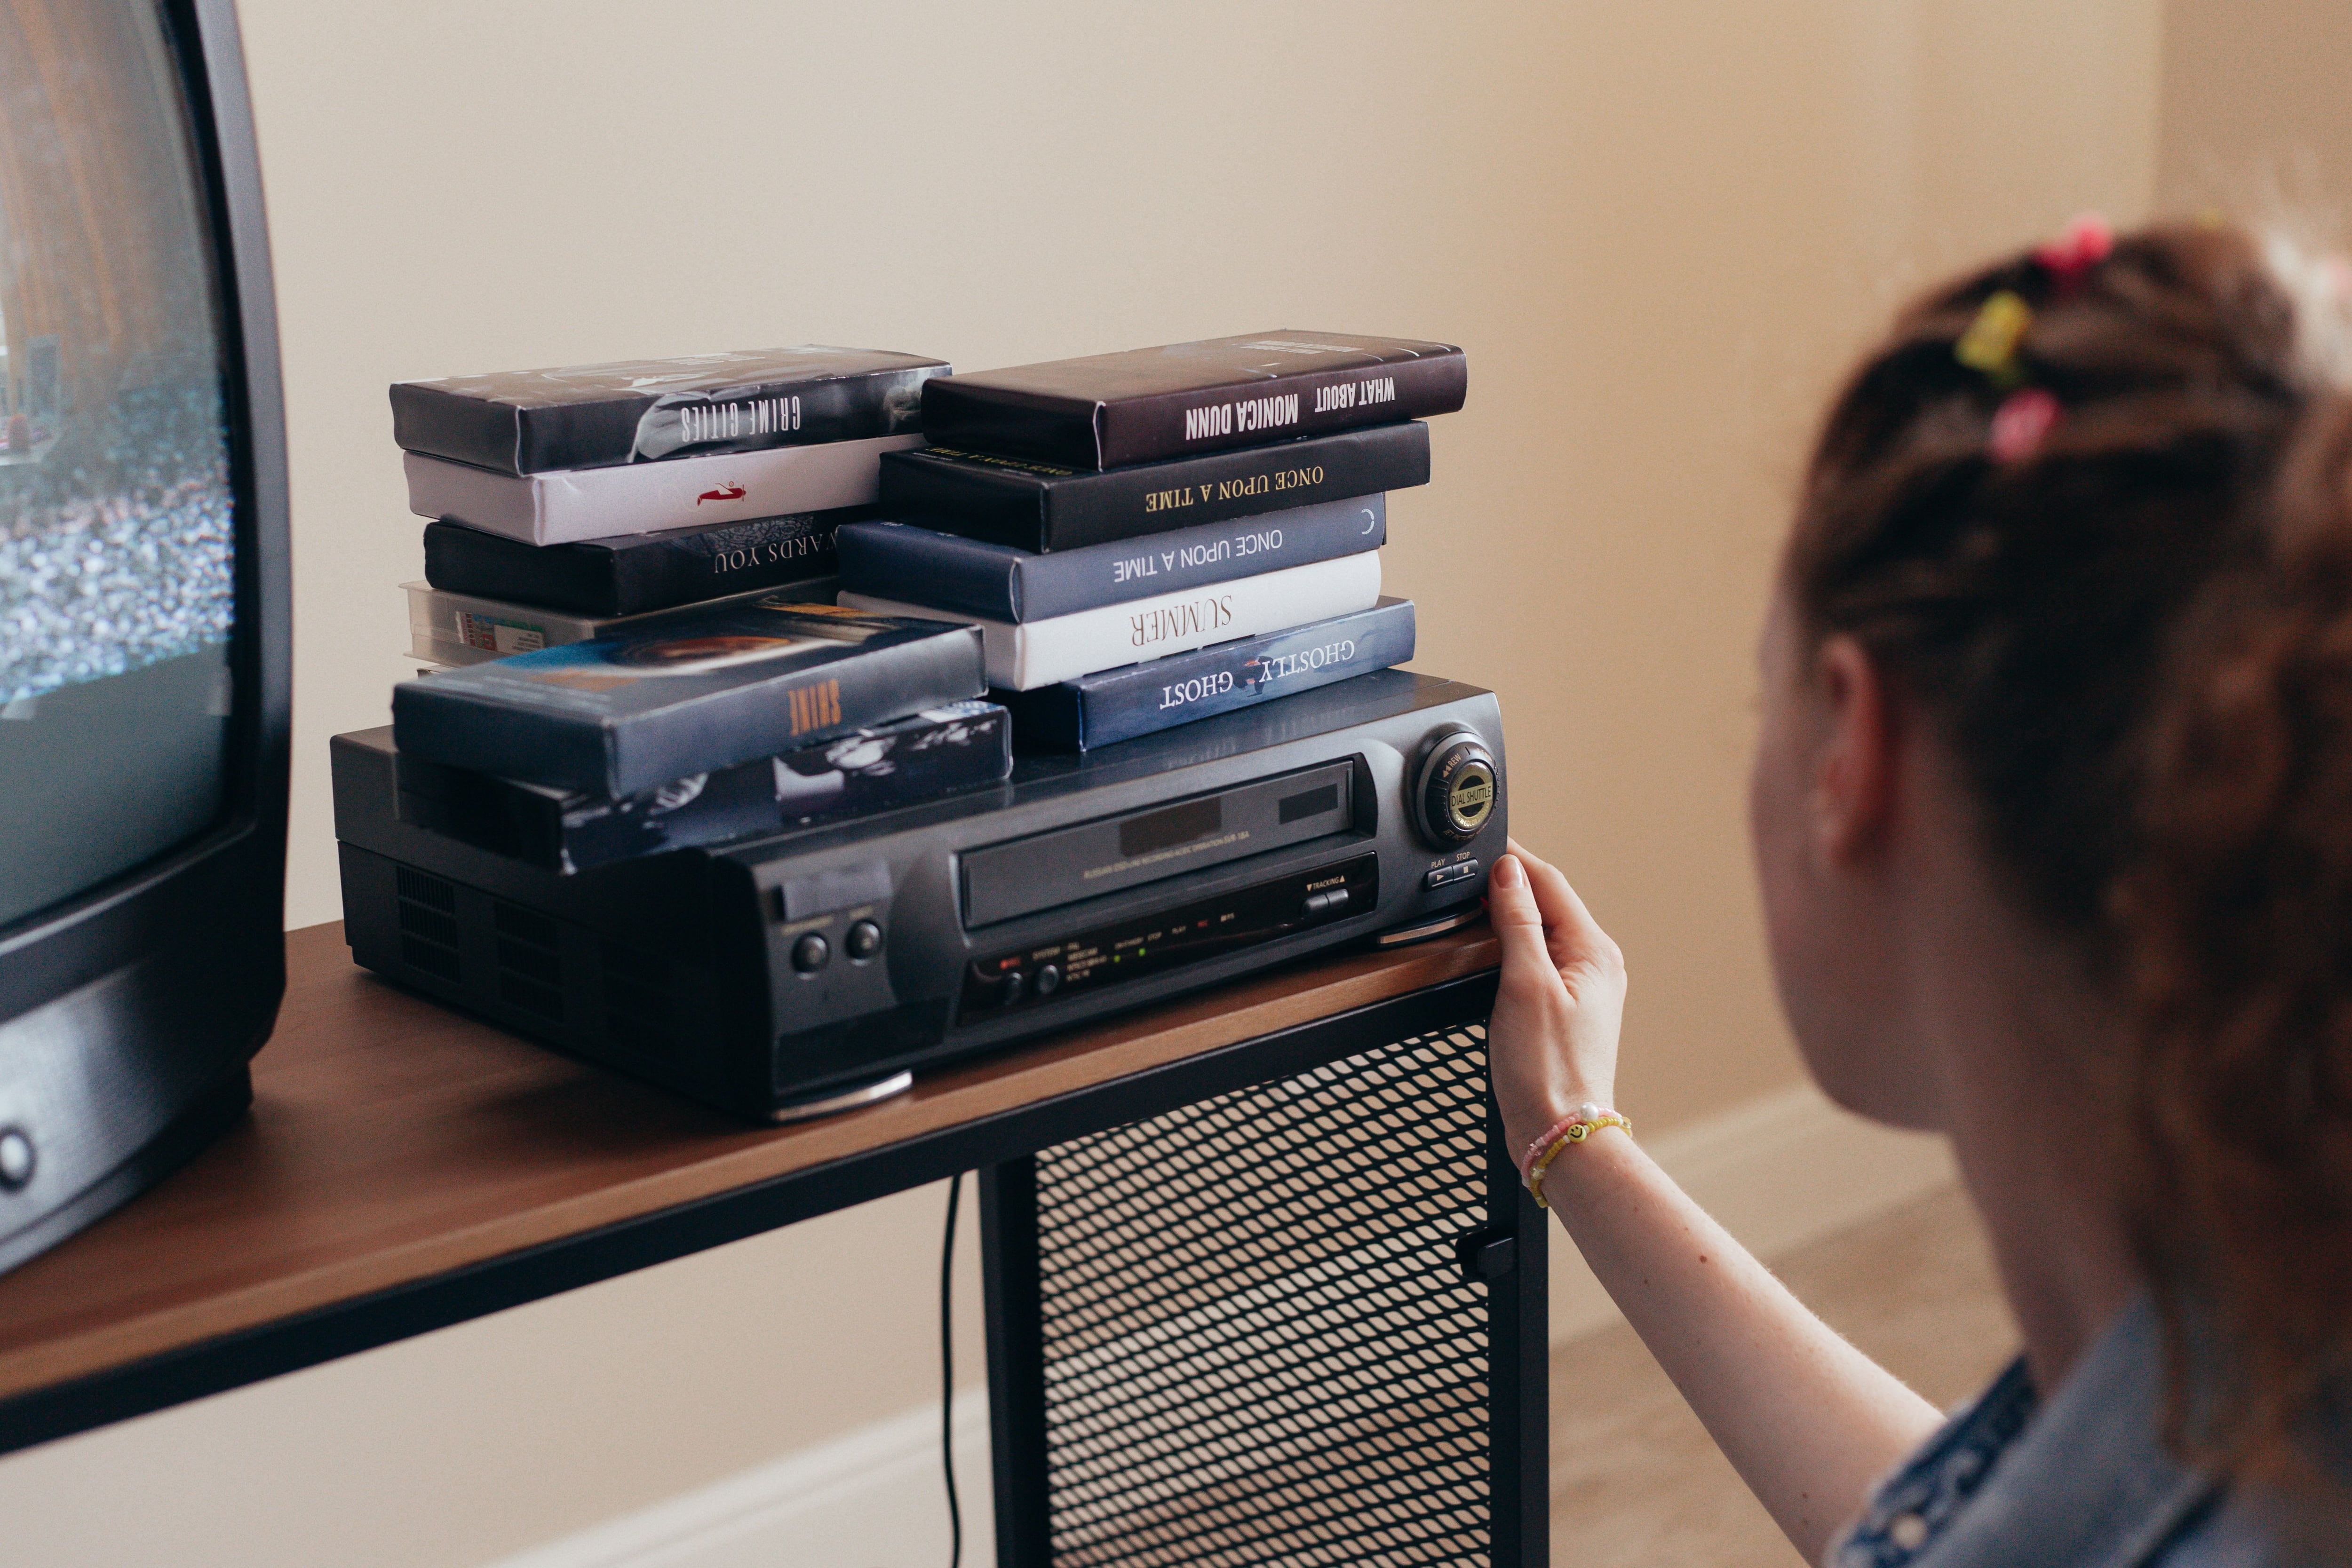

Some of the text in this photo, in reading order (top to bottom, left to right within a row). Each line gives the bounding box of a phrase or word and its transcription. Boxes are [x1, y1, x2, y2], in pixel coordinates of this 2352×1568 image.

[1314, 377, 1395, 412] WHAT ABOUT
[681, 396, 801, 443] CRIME CITIES
[1185, 394, 1299, 441] MONICA DUNN
[1145, 466, 1324, 512] ONCE UPON A TIME
[715, 548, 760, 573] YOU
[1113, 530, 1283, 583] ONCE UPON A TIME
[1130, 595, 1232, 646] SUMMER
[1159, 640, 1355, 710] GHOSTLY GHOST
[1448, 753, 1462, 768] REW
[1452, 786, 1491, 807] DIAL SHUTTLE
[1431, 851, 1470, 869] PLAY STOP
[1312, 877, 1339, 890] TRACKING
